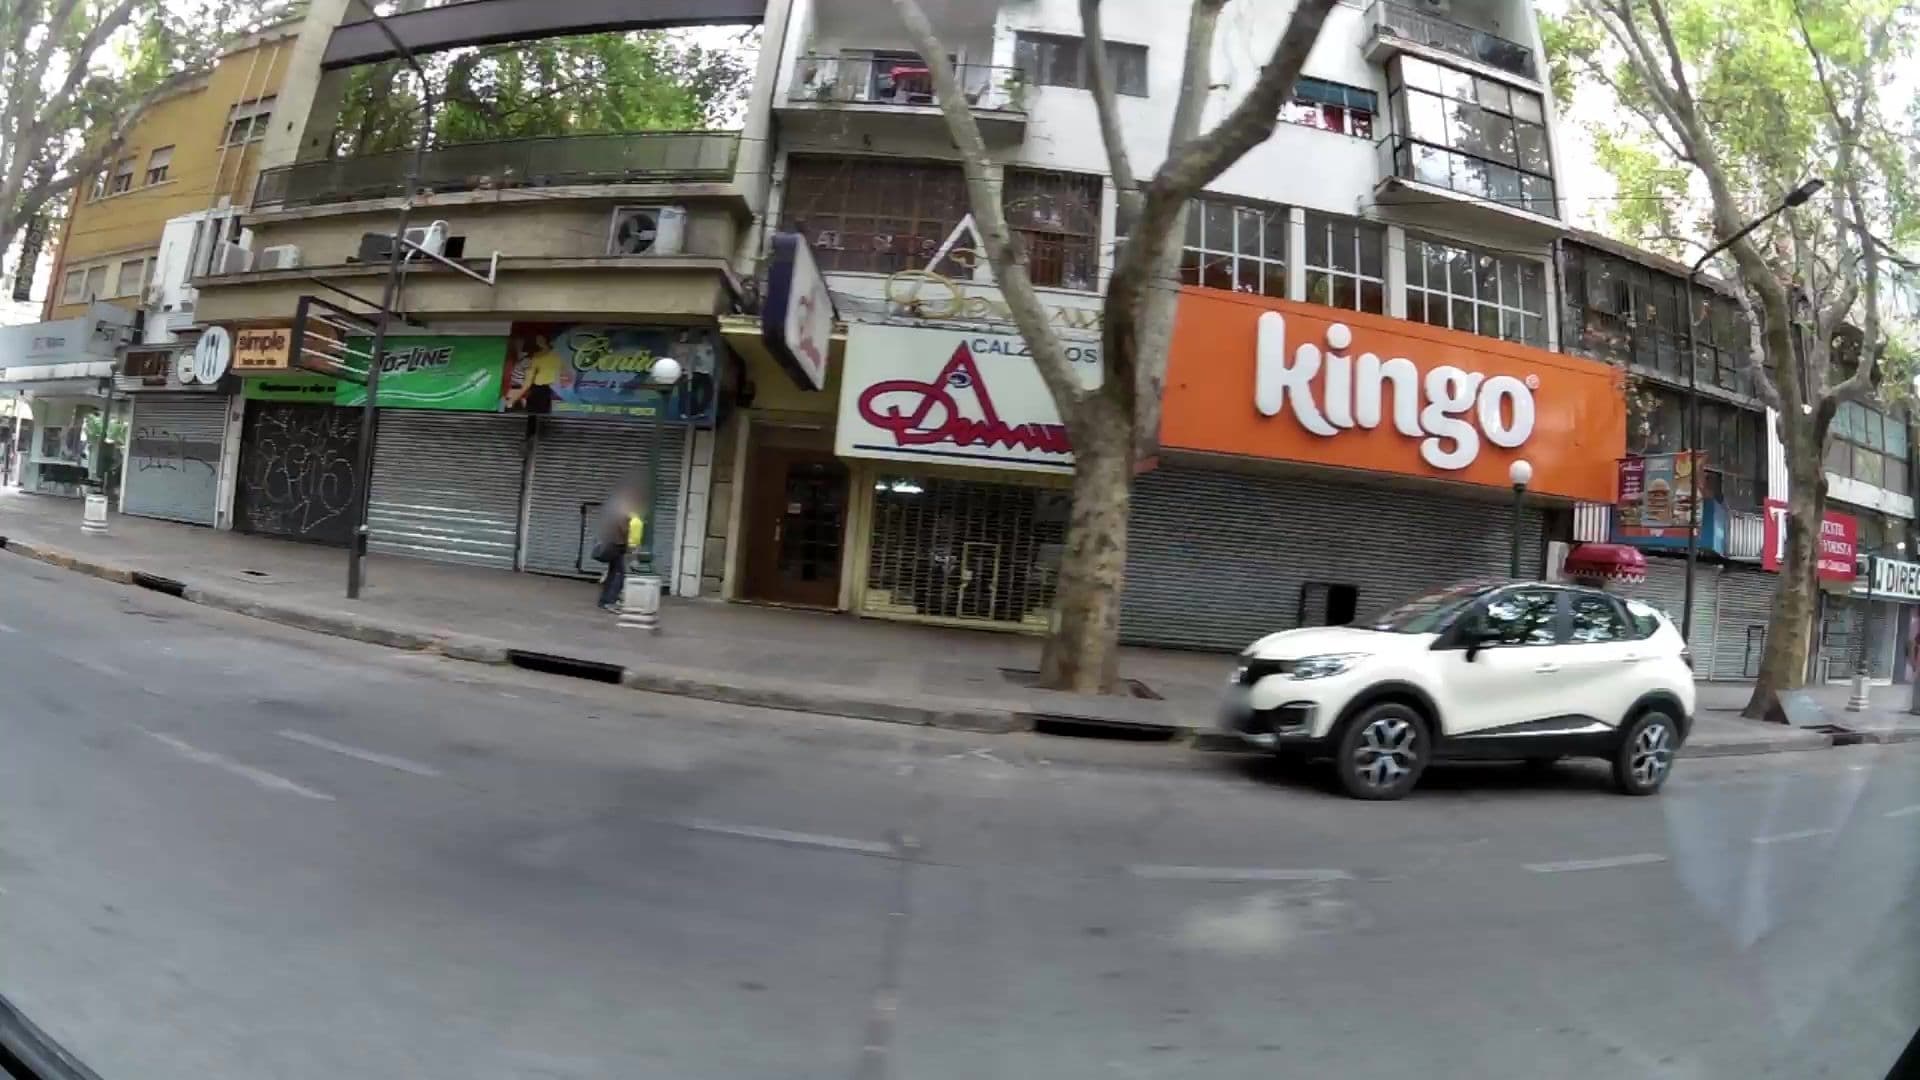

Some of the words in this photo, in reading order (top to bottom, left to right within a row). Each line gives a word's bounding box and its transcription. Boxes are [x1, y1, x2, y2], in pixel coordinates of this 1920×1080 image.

[239, 331, 285, 355] simple
[972, 338, 1098, 363] CALZOS
[1255, 311, 1537, 471] kingo
